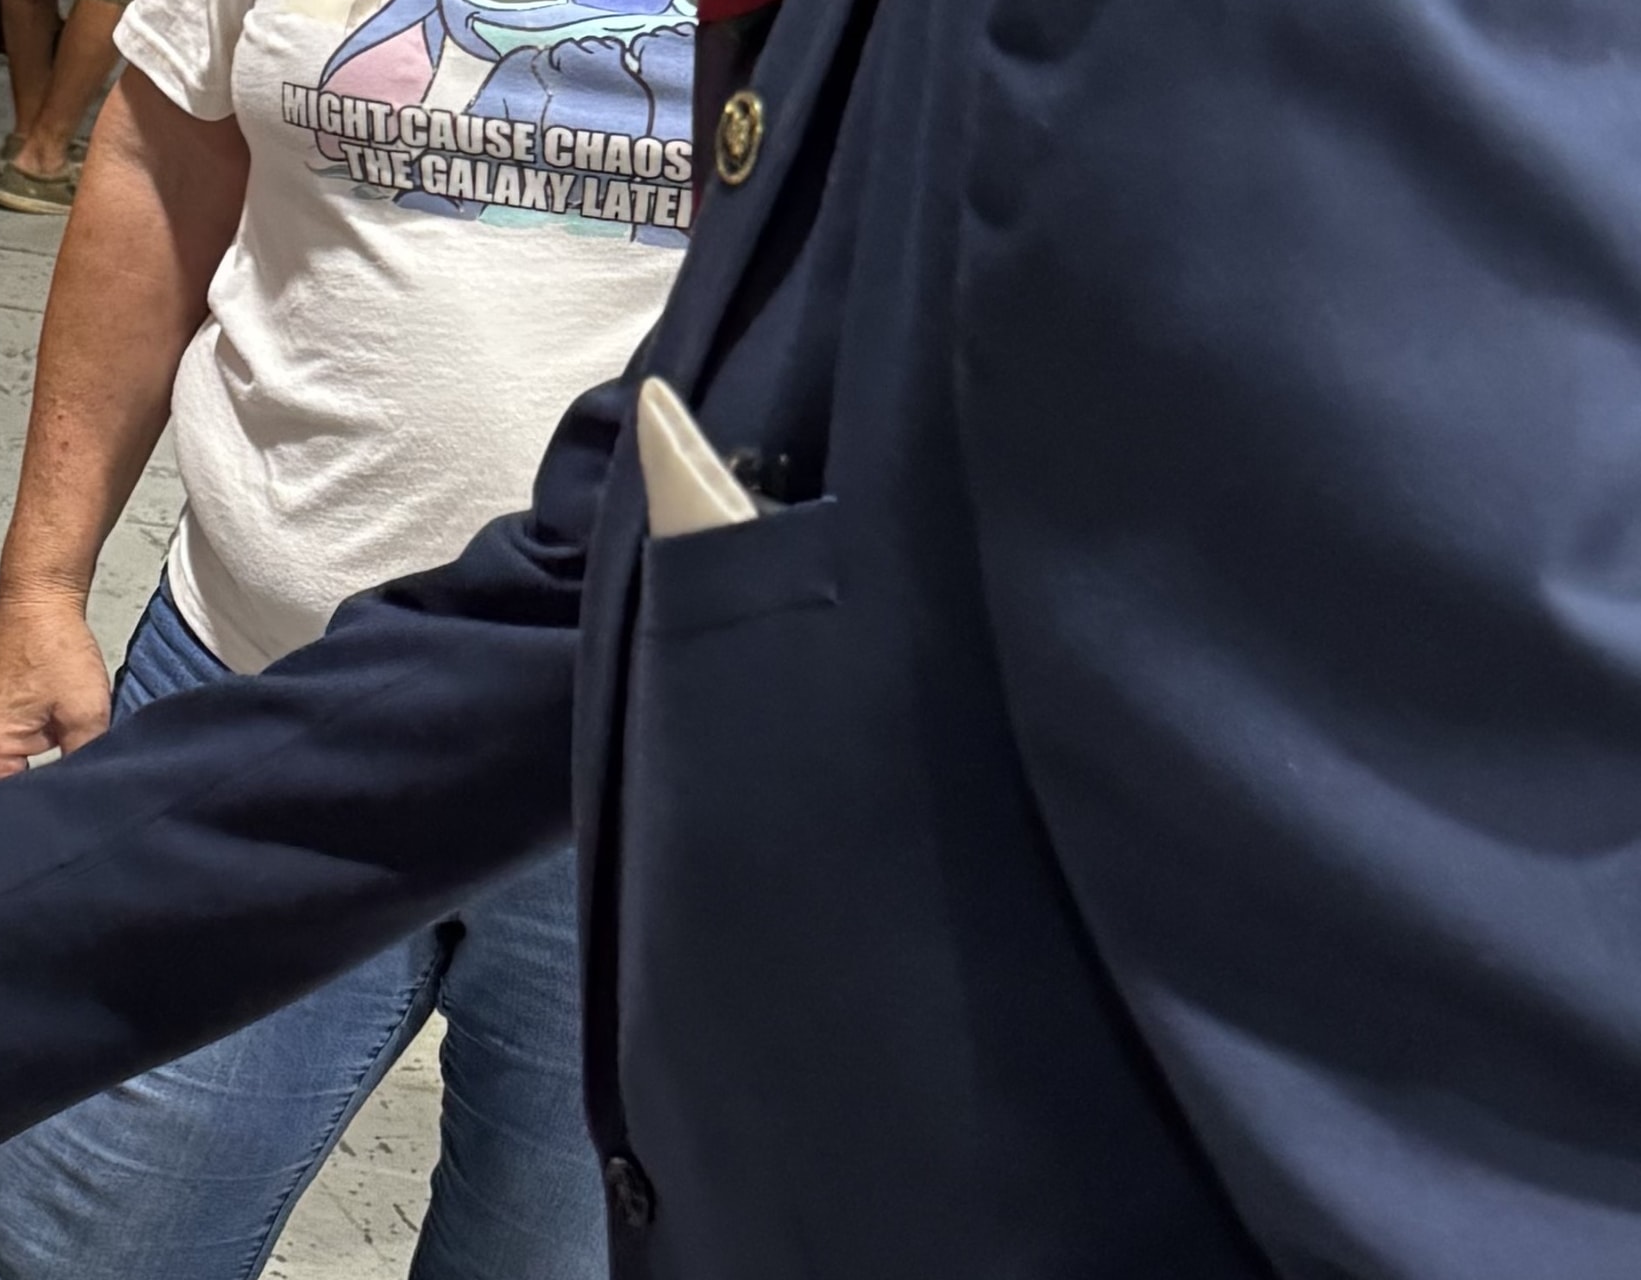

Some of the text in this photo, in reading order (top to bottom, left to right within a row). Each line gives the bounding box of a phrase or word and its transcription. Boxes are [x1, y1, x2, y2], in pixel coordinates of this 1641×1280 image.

[281, 81, 693, 183] MIGHT CAUSE CHAOS
[340, 142, 414, 189] THE
[420, 153, 577, 214] GALAXY
